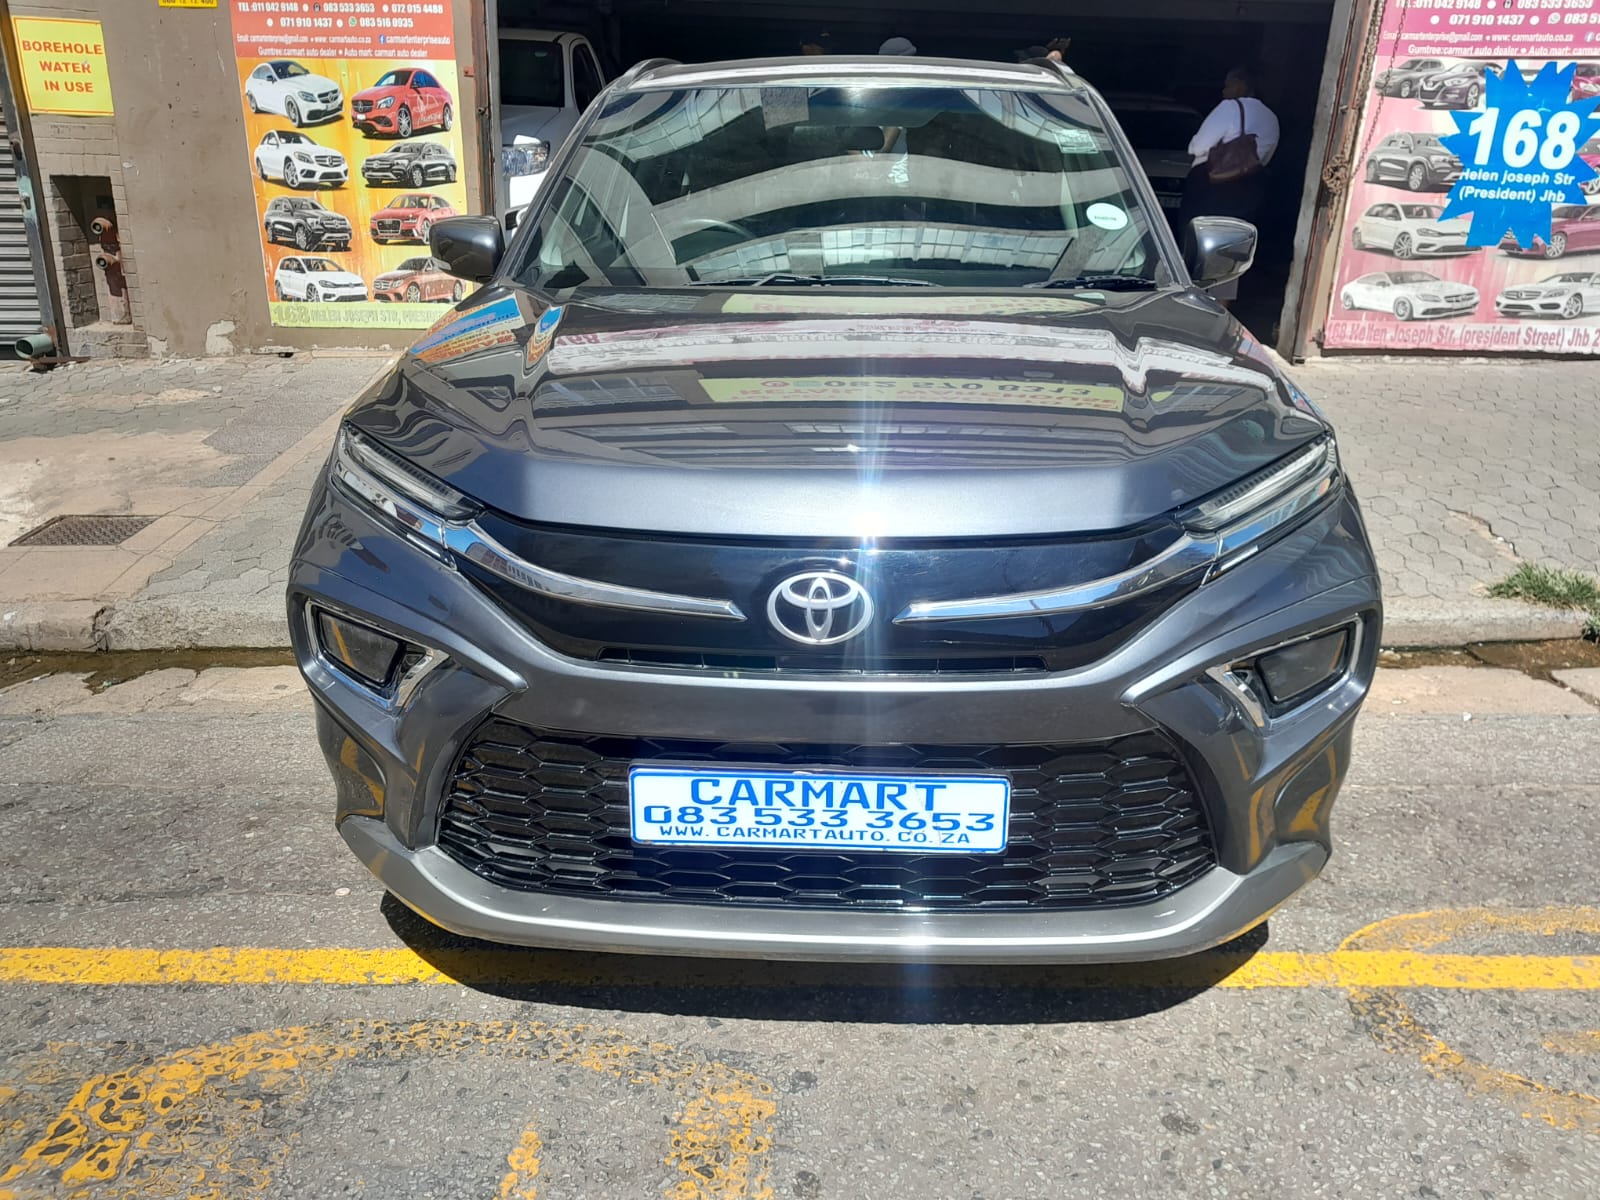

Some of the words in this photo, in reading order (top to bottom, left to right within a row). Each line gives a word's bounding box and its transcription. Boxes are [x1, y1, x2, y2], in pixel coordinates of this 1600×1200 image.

[391, 3, 406, 13] 072
[406, 3, 422, 14] 015
[279, 16, 294, 27] 071
[295, 17, 312, 27] 910
[313, 17, 333, 27] 1437
[359, 17, 376, 28] 083
[1449, 14, 1471, 25] 071
[1471, 14, 1495, 25] 910
[1496, 14, 1525, 26] 1437
[1563, 13, 1588, 24] 083
[22, 40, 104, 55] BOREHOLE
[39, 60, 92, 74] WATER
[43, 80, 60, 92] IN
[64, 80, 94, 93] USE
[1468, 106, 1580, 170] 168
[1500, 170, 1550, 186] joseph
[1553, 172, 1576, 185] Str
[1459, 186, 1537, 203] (President)
[1539, 189, 1566, 203] Jhb
[1390, 323, 1434, 345] Joseph
[1567, 327, 1590, 346] Jhb
[690, 778, 947, 812] CARMART
[643, 805, 739, 826] 083
[754, 807, 849, 829] 533
[866, 810, 995, 832] 3653
